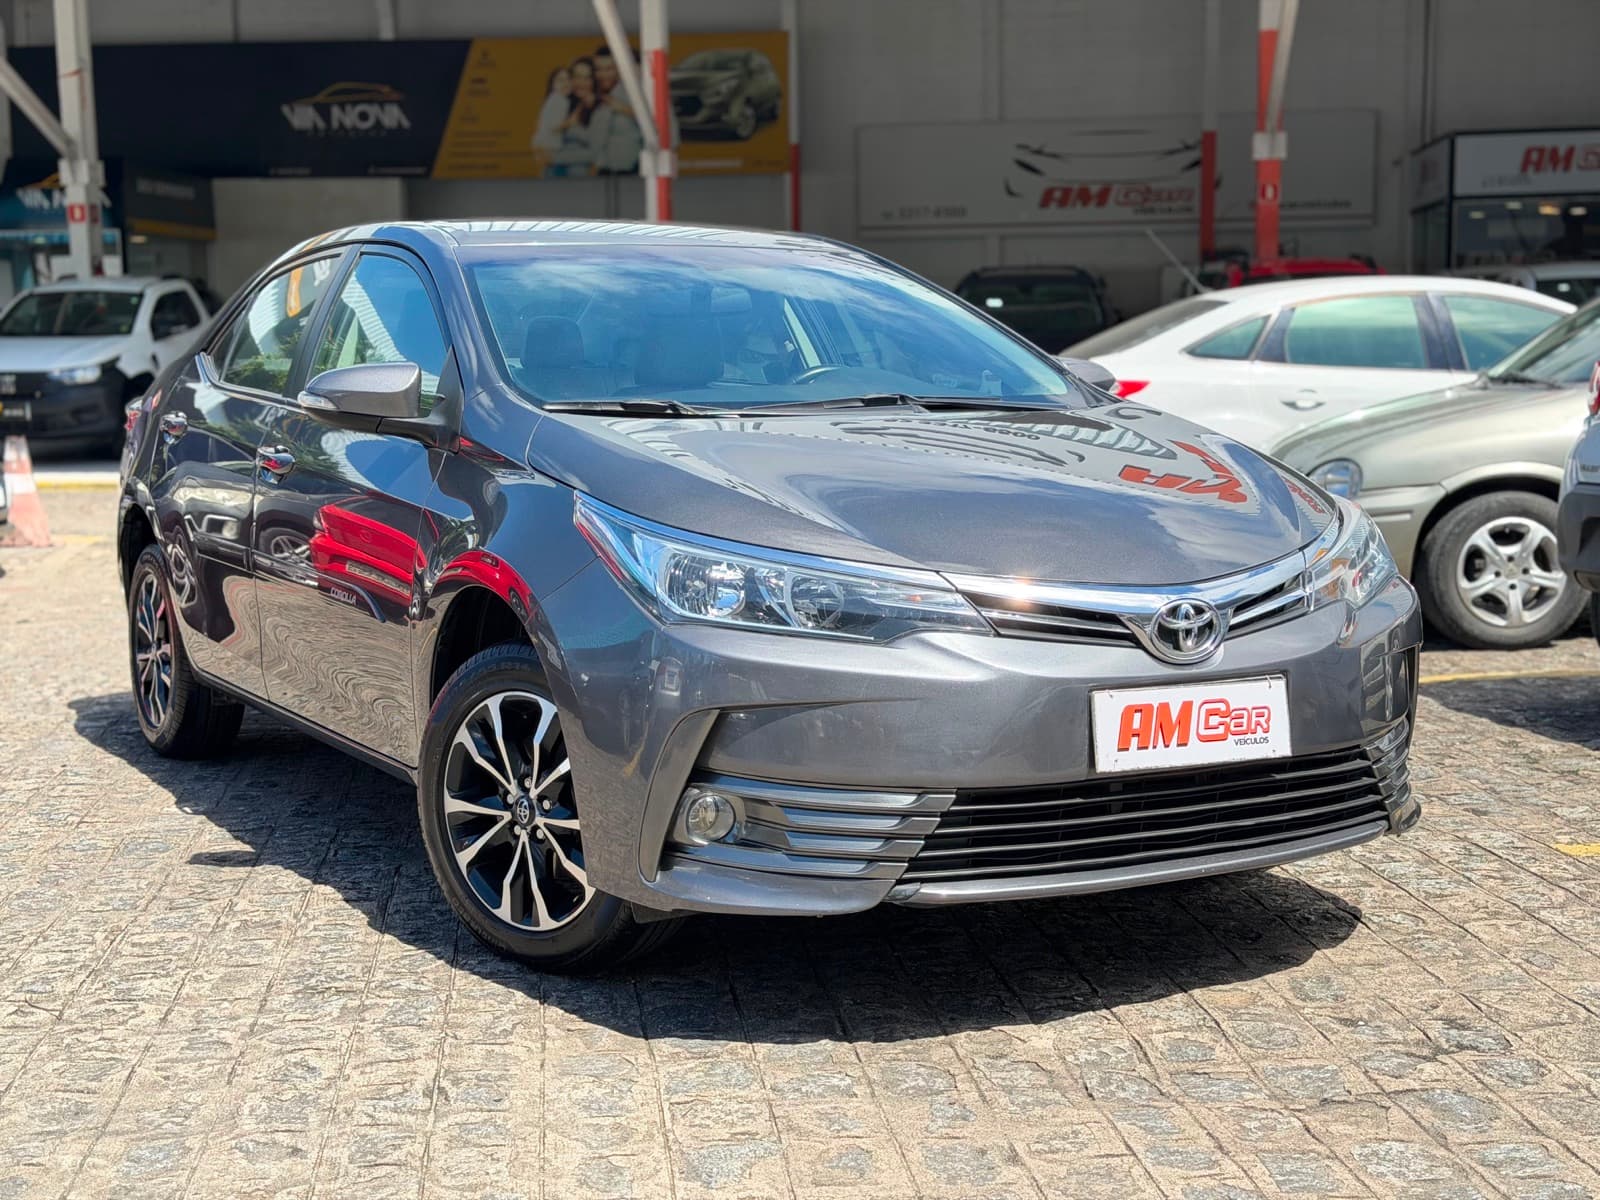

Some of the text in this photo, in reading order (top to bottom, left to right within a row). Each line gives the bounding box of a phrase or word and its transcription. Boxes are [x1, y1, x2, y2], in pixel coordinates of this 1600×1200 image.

[330, 103, 411, 130] NOVA
[1518, 145, 1576, 174] AM
[1039, 184, 1113, 208] AM
[331, 588, 356, 604] COROLLA
[1117, 700, 1194, 752] AM
[1234, 737, 1270, 746] VEÍCULOS
